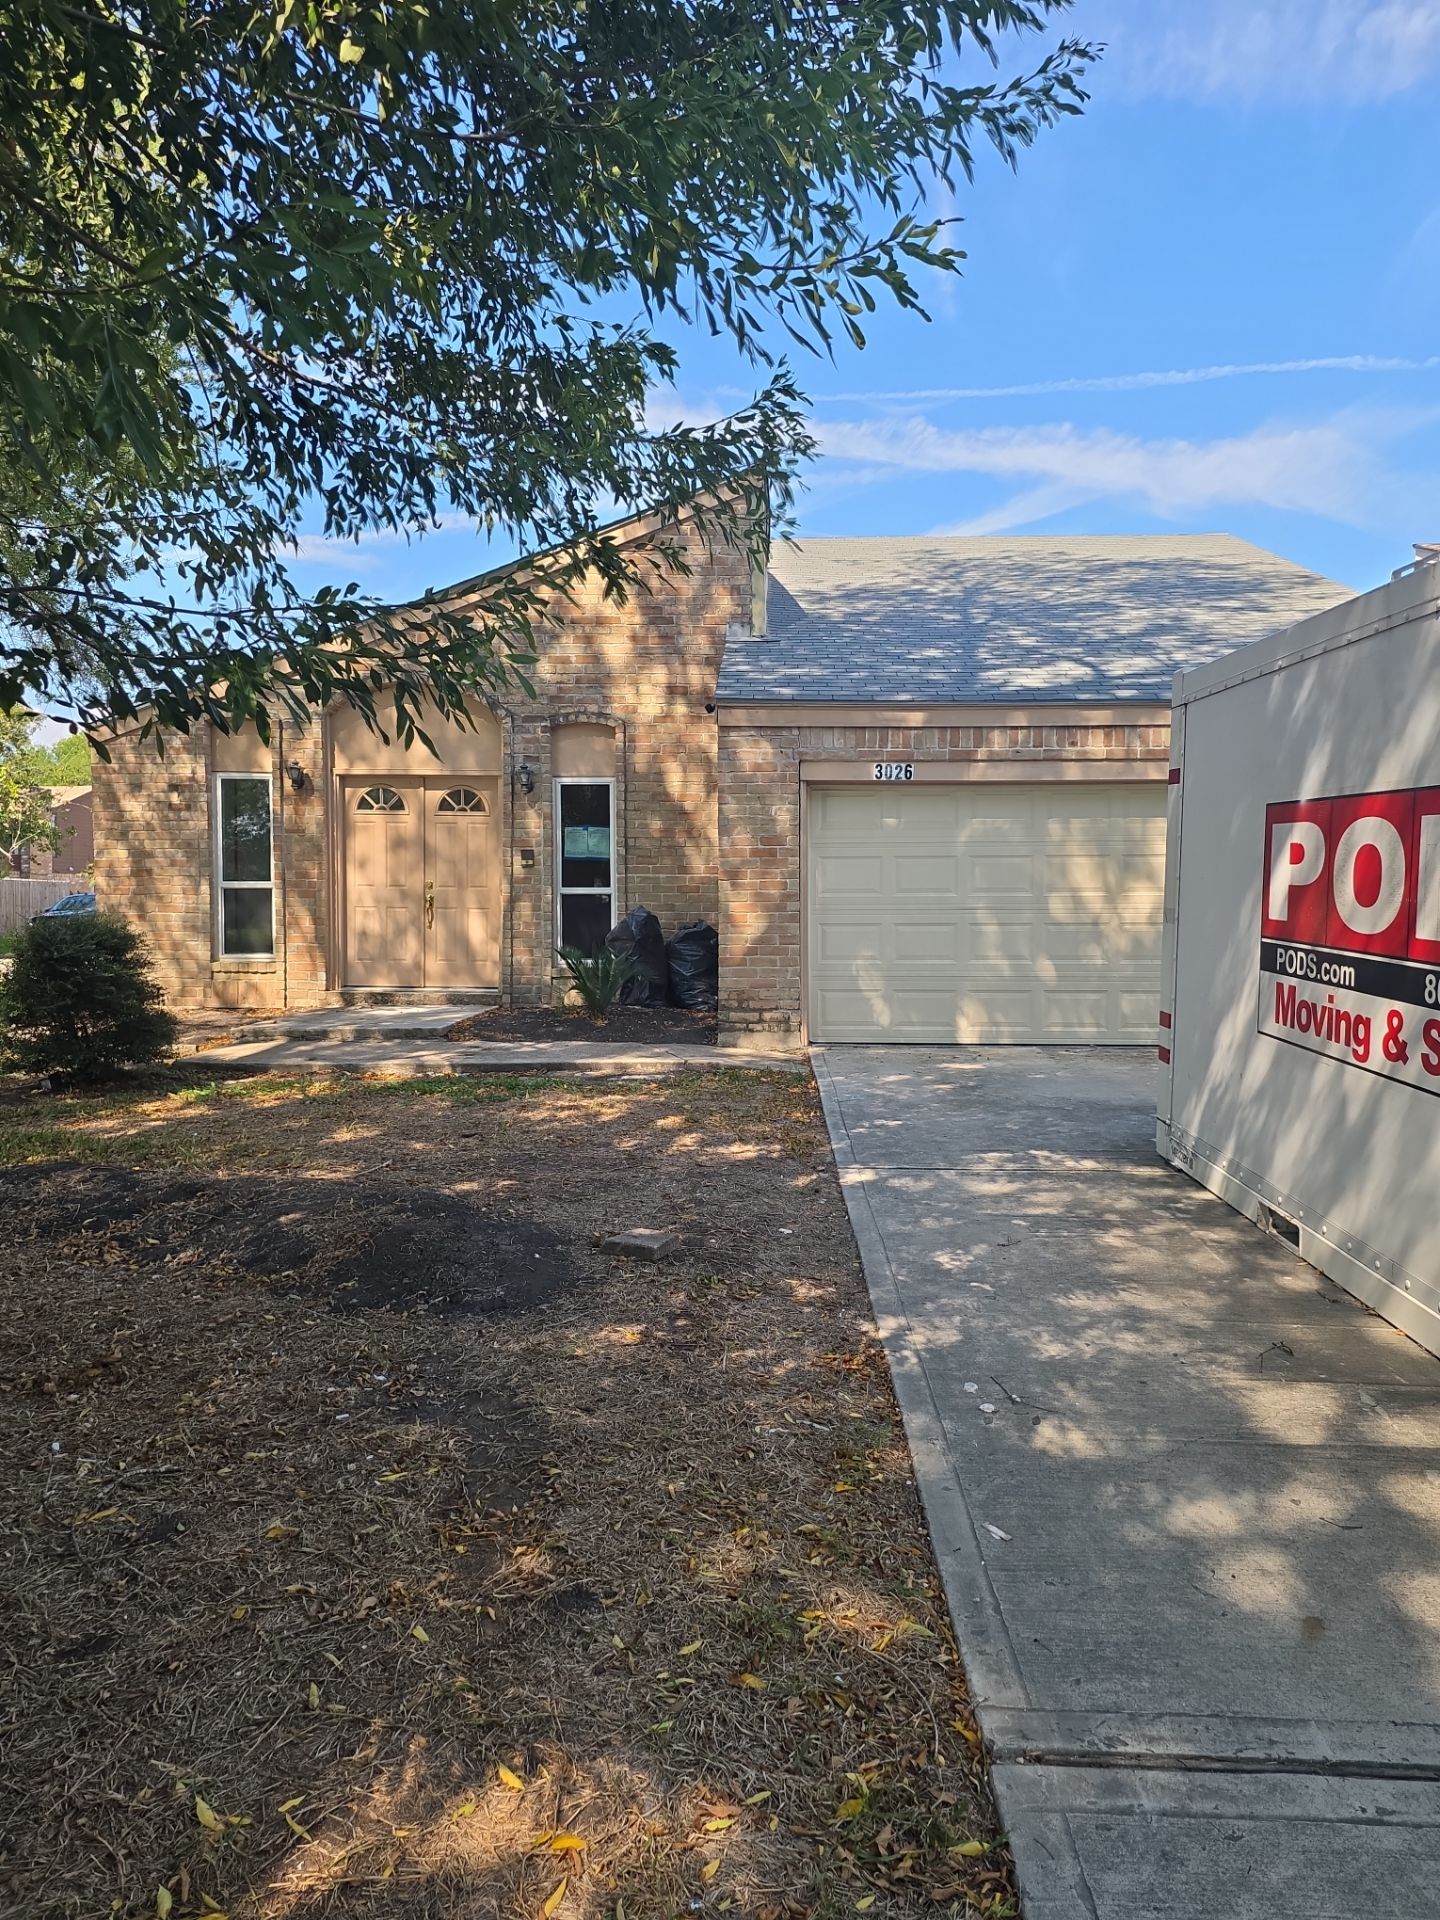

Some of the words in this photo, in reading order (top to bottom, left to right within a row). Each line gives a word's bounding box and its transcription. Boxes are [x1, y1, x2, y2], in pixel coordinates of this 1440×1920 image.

[874, 763, 913, 780] 3026
[1276, 947, 1355, 987] PODS.com
[1424, 973, 1440, 1005] 8
[1274, 981, 1371, 1063] Moving
[1382, 1008, 1410, 1066] &
